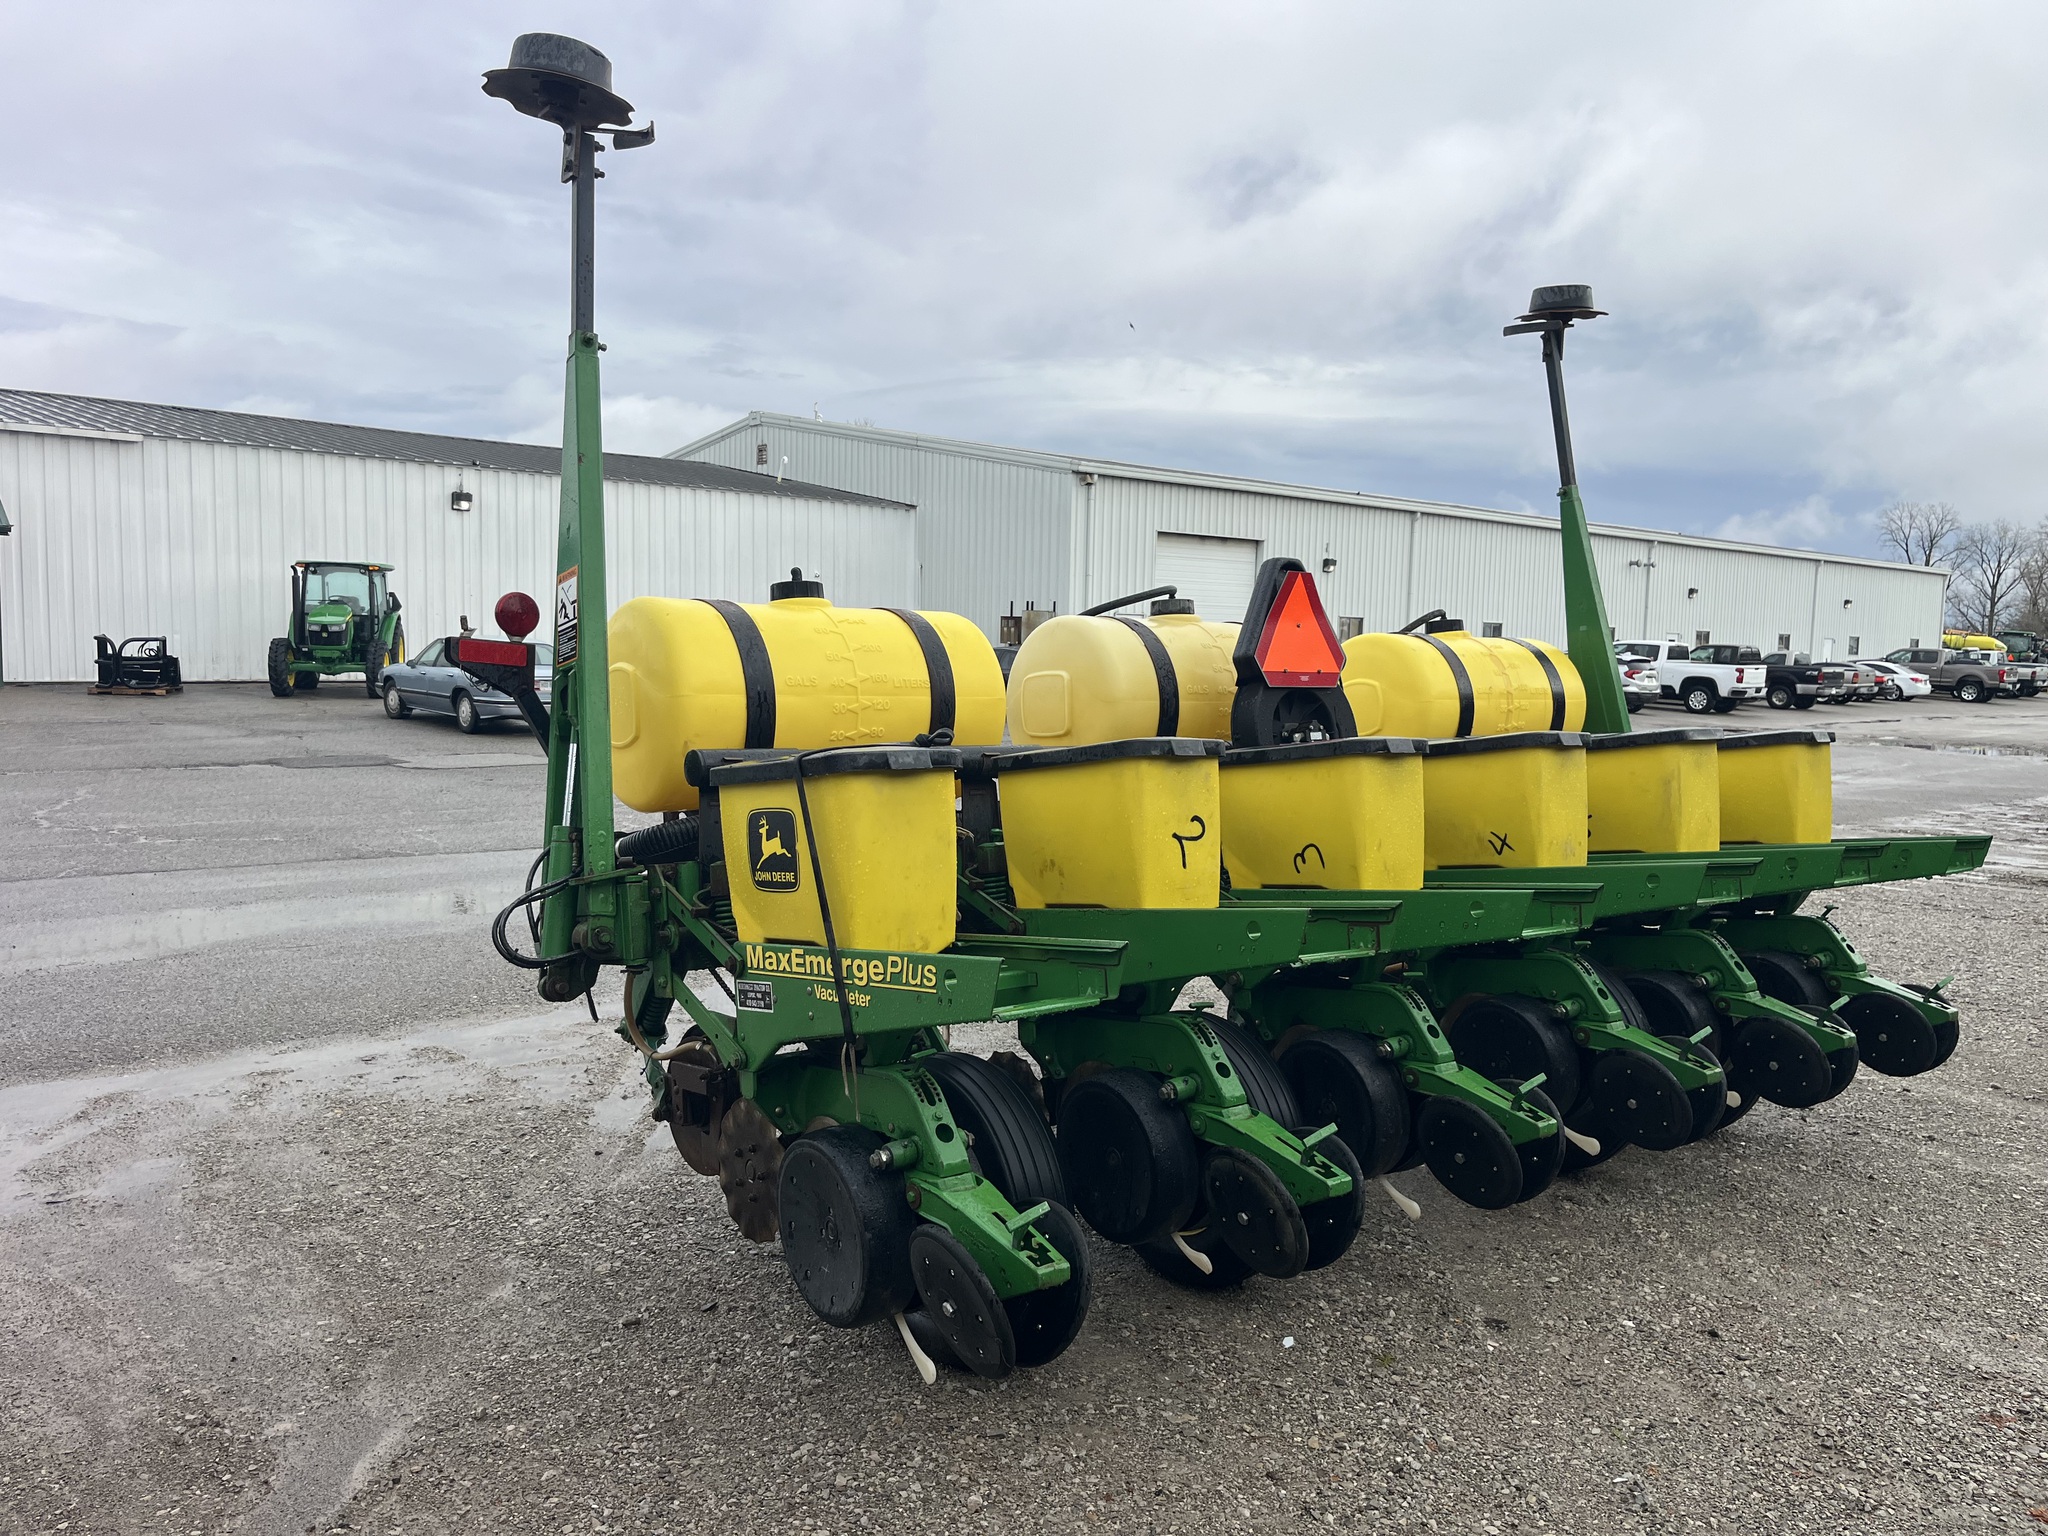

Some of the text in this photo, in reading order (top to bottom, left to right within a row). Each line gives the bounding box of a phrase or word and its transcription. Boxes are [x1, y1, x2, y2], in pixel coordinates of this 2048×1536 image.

[862, 644, 882, 653] 200
[826, 651, 841, 661] 50
[785, 675, 818, 687] GALS
[831, 678, 846, 688] 40
[870, 673, 889, 683] 160
[893, 678, 931, 689] LITERS
[1186, 684, 1209, 695] GALS
[833, 703, 848, 714] 30
[872, 699, 890, 710] 120
[830, 730, 845, 741] 20
[754, 871, 796, 882] JOHN DEERE
